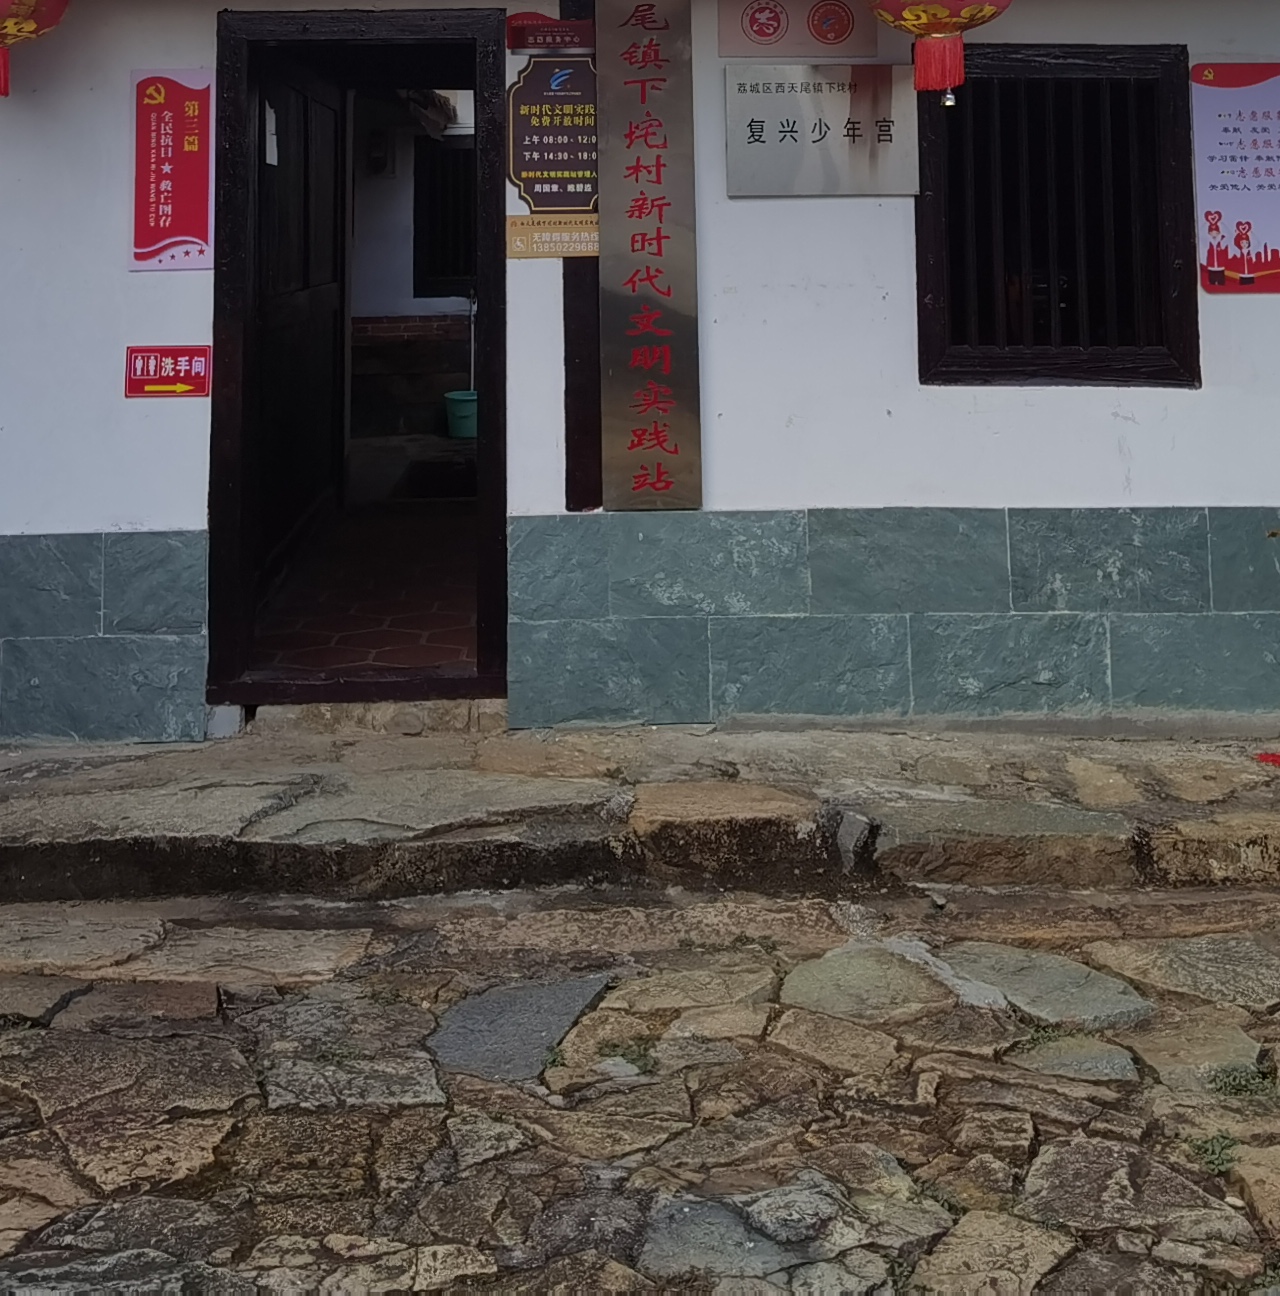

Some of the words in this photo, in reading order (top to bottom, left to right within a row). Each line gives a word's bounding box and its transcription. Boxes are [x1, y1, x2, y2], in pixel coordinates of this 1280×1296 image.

[736, 81, 858, 94] 荔城区西天尾镇下垞村
[519, 104, 598, 116] 新时代文明实践
[183, 100, 200, 152] 第三篇
[530, 116, 595, 127] 免费开放时间
[160, 110, 174, 158] 全民抗日
[746, 117, 895, 145] 复兴少年宫
[522, 135, 540, 145] 上午
[523, 151, 540, 161] 下午
[158, 179, 173, 228] 救亡图存
[161, 356, 205, 377] 洗手间
